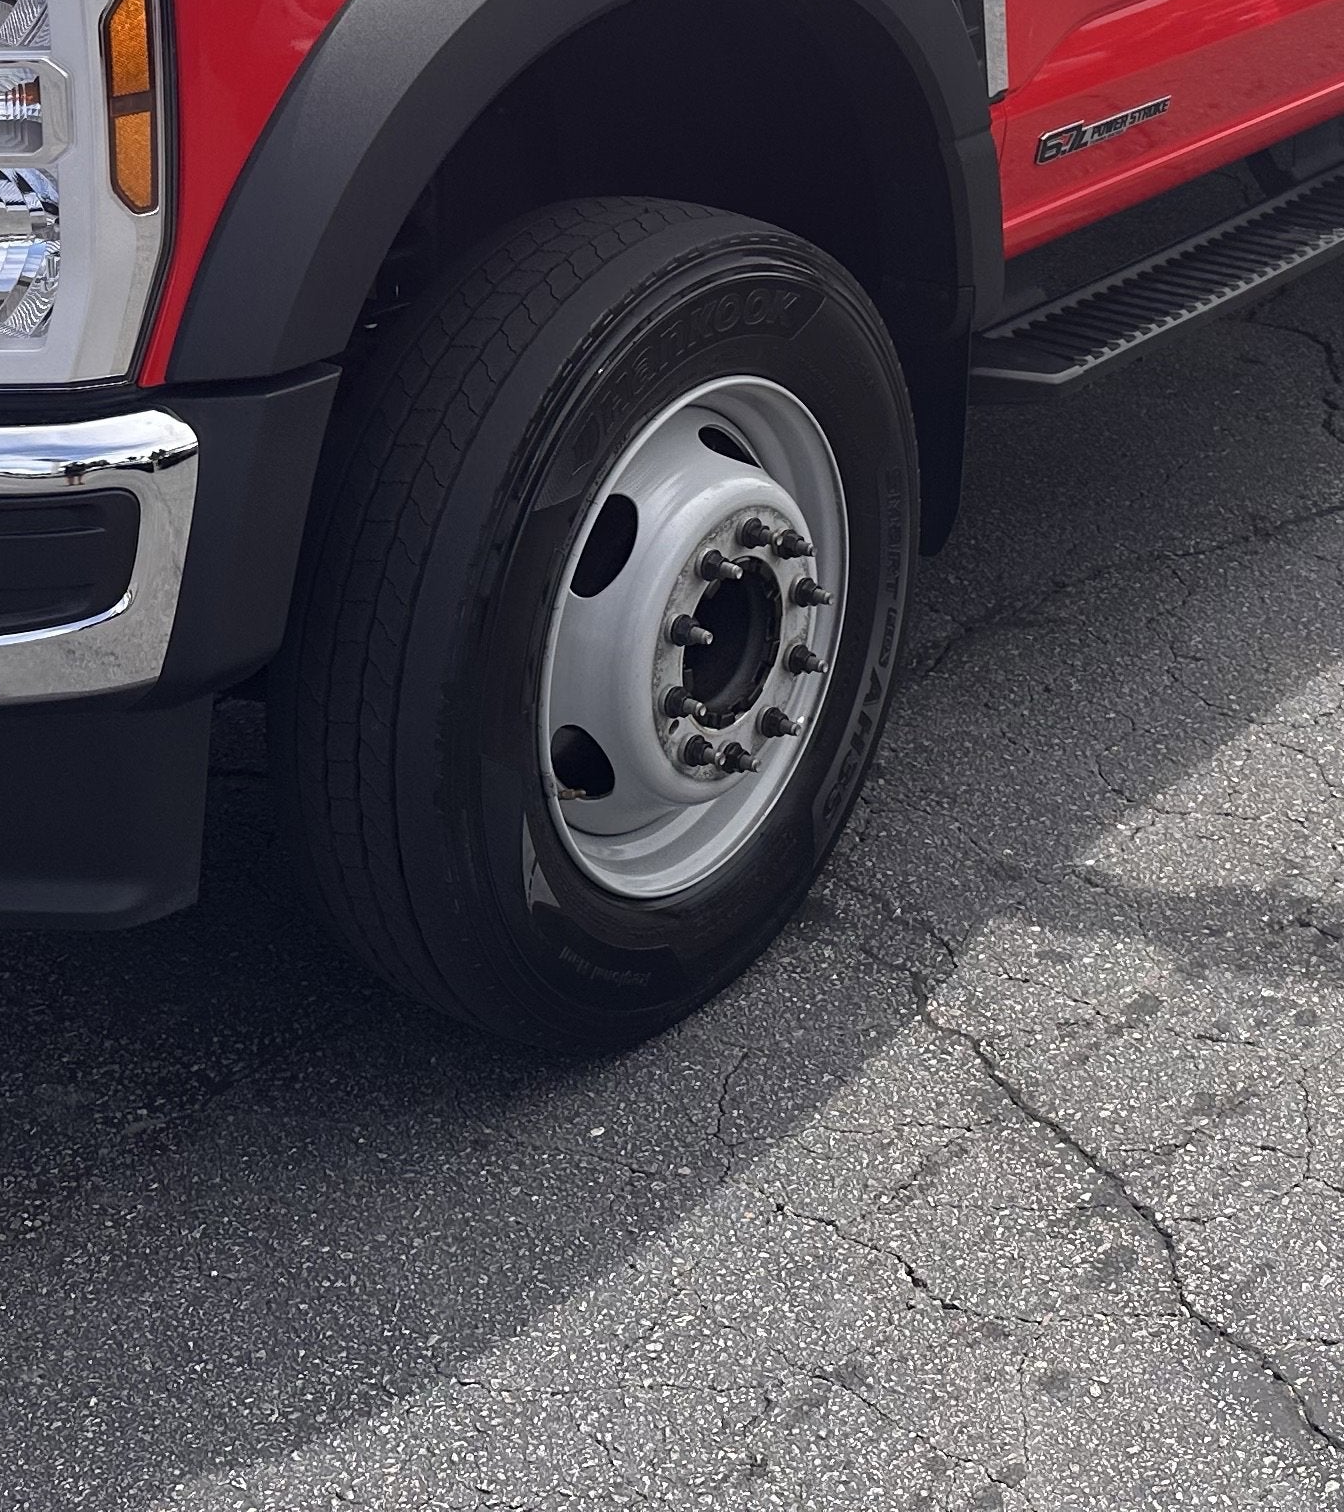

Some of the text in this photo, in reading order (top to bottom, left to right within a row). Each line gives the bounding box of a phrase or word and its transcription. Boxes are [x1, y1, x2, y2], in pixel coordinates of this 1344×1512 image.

[1037, 121, 1089, 164] 6.7L
[1091, 115, 1129, 139] POWER
[1129, 99, 1170, 125] STROKE
